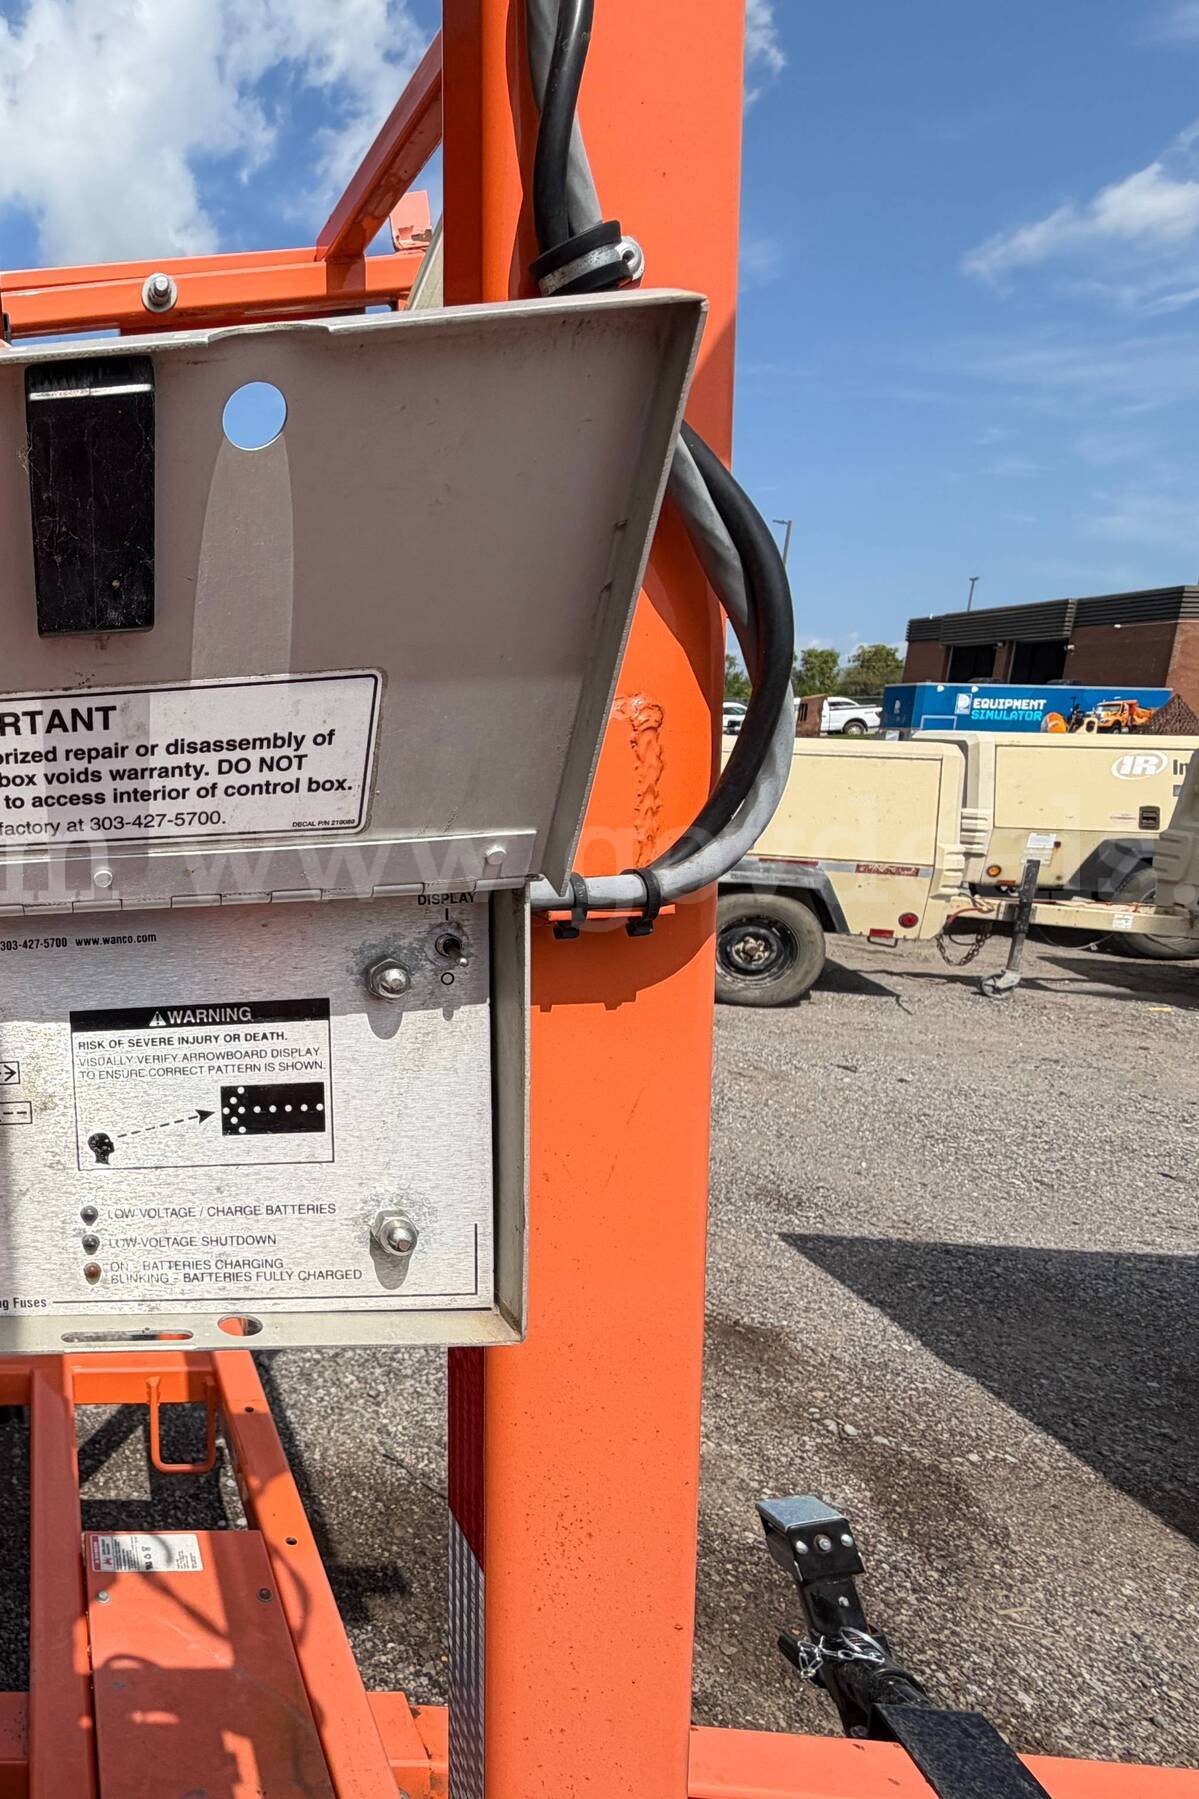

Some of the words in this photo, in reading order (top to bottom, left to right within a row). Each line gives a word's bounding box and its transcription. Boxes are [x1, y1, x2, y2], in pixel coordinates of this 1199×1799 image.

[973, 698, 1047, 710] EQUIPMENT
[971, 710, 1042, 721] SIMULATOR
[65, 742, 128, 764] repair
[135, 742, 159, 757] or
[165, 731, 306, 757] disassembly
[312, 729, 336, 747] of
[44, 767, 102, 785] voids
[109, 762, 210, 782] warranty.
[217, 757, 251, 775] DO
[259, 754, 308, 772] NOT
[5, 796, 25, 810] to
[32, 791, 105, 808] access
[113, 787, 190, 804] interior
[196, 782, 218, 799] of
[223, 778, 300, 797] control
[307, 777, 353, 794] box.
[66, 819, 85, 832] at
[89, 810, 227, 831] 303-427-5700.
[417, 891, 476, 905] DISPLAY
[0, 936, 68, 952] 303-427-5700
[75, 932, 157, 948] www.wanco.com
[168, 1006, 252, 1025] WARNING
[78, 1040, 105, 1051] RISK
[109, 1039, 124, 1049] OF
[128, 1036, 175, 1048] SEVERE
[177, 1033, 220, 1046] INJURY
[223, 1032, 241, 1043] OR
[244, 1031, 288, 1042] DEATH.
[78, 1054, 133, 1068] VISUALLY
[136, 1053, 178, 1065] VERIFY
[181, 1049, 268, 1062] ARROWBOARD
[271, 1047, 320, 1059] DISPLAY
[79, 1070, 96, 1080] TO
[99, 1067, 146, 1080] ENSURE
[148, 1065, 205, 1078] CORRECT
[208, 1062, 262, 1075] PATTERN
[264, 1062, 276, 1072] IS
[278, 1060, 327, 1073] SHOWN.
[207, 1205, 261, 1217] CHARGE
[266, 1203, 337, 1216] BATTERIES
[108, 1235, 199, 1248] LOW-VOLTAGE
[200, 1234, 277, 1247] SHUTDOWN
[143, 1259, 212, 1271] BATTERIES
[215, 1258, 284, 1270] CHARGING
[110, 1271, 169, 1284] BLINKING
[183, 1270, 252, 1283] BATTERIES
[256, 1269, 295, 1282] FULLY
[298, 1268, 362, 1281] CHARGED
[13, 1297, 47, 1308] Fuses
